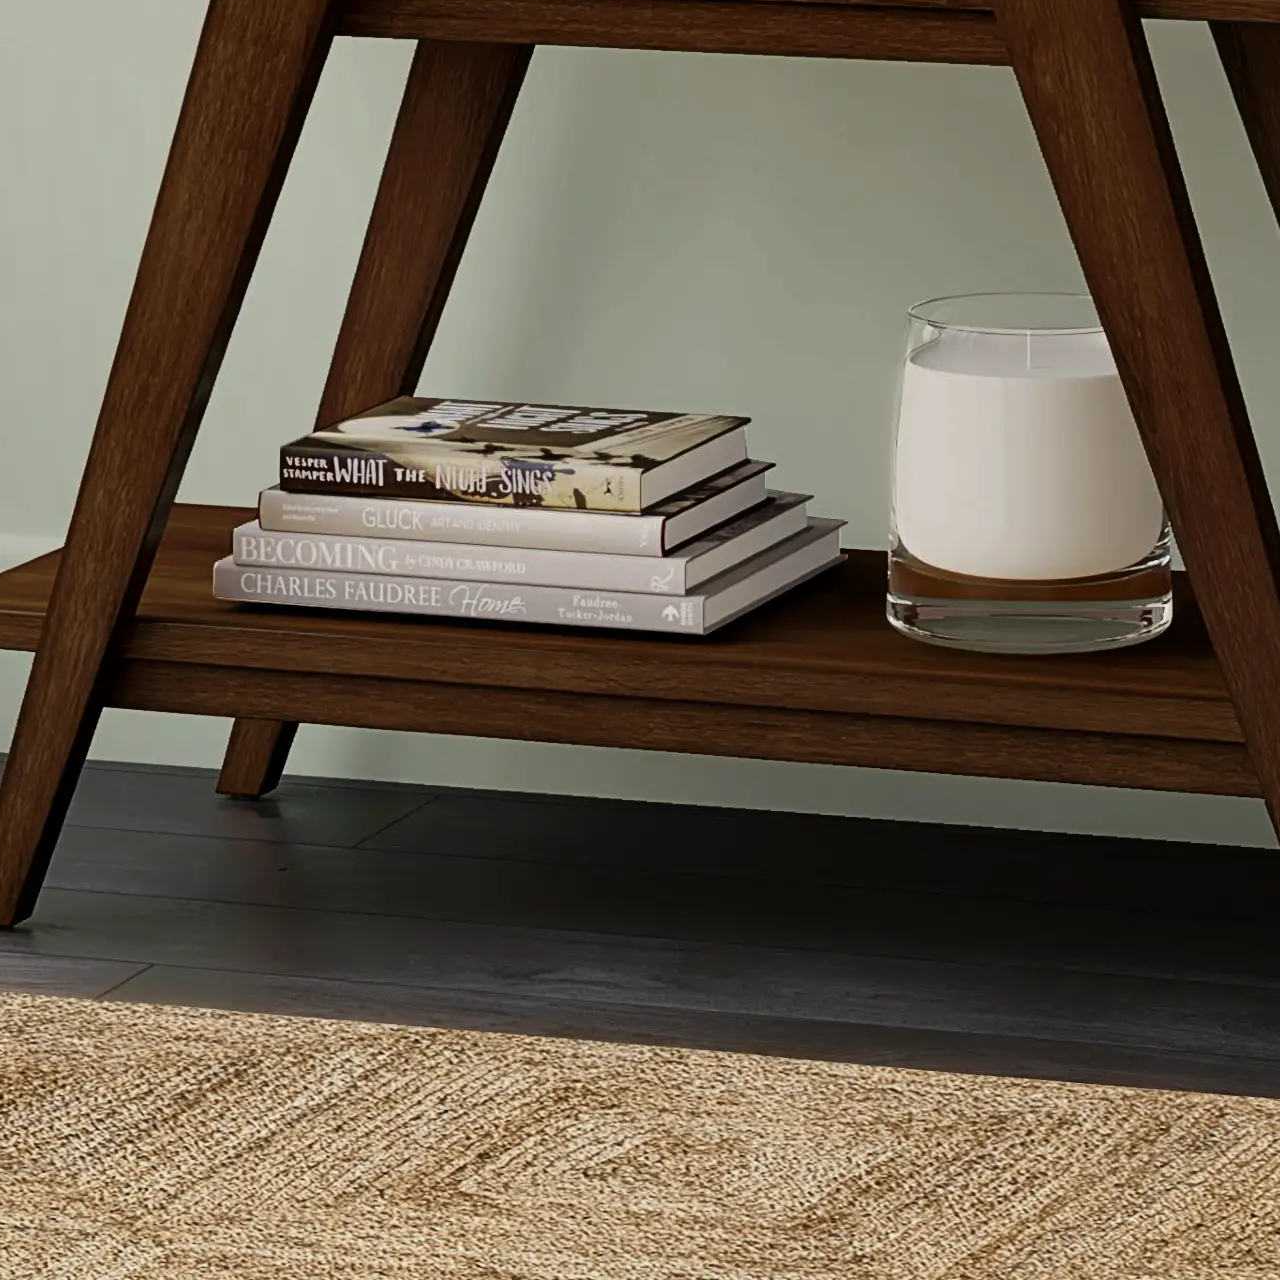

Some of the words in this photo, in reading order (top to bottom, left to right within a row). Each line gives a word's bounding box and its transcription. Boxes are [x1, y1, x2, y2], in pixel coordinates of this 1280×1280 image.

[285, 456, 329, 469] VESPER
[282, 468, 335, 482] STAMPER
[332, 455, 388, 487] WHAT
[393, 468, 427, 483] THE
[498, 466, 554, 496] SINGS
[362, 506, 424, 531] GLUCK
[430, 517, 451, 529] ART
[240, 536, 399, 572] BECOMING
[404, 554, 418, 570] by
[419, 555, 455, 570] CINDY
[456, 558, 526, 574] CRAWFORD
[240, 572, 337, 600] CHARLES
[344, 580, 442, 607] FAUDREE
[448, 584, 526, 616] Home
[572, 594, 619, 609] Faudree
[557, 606, 633, 623] Tucker-Jordan
